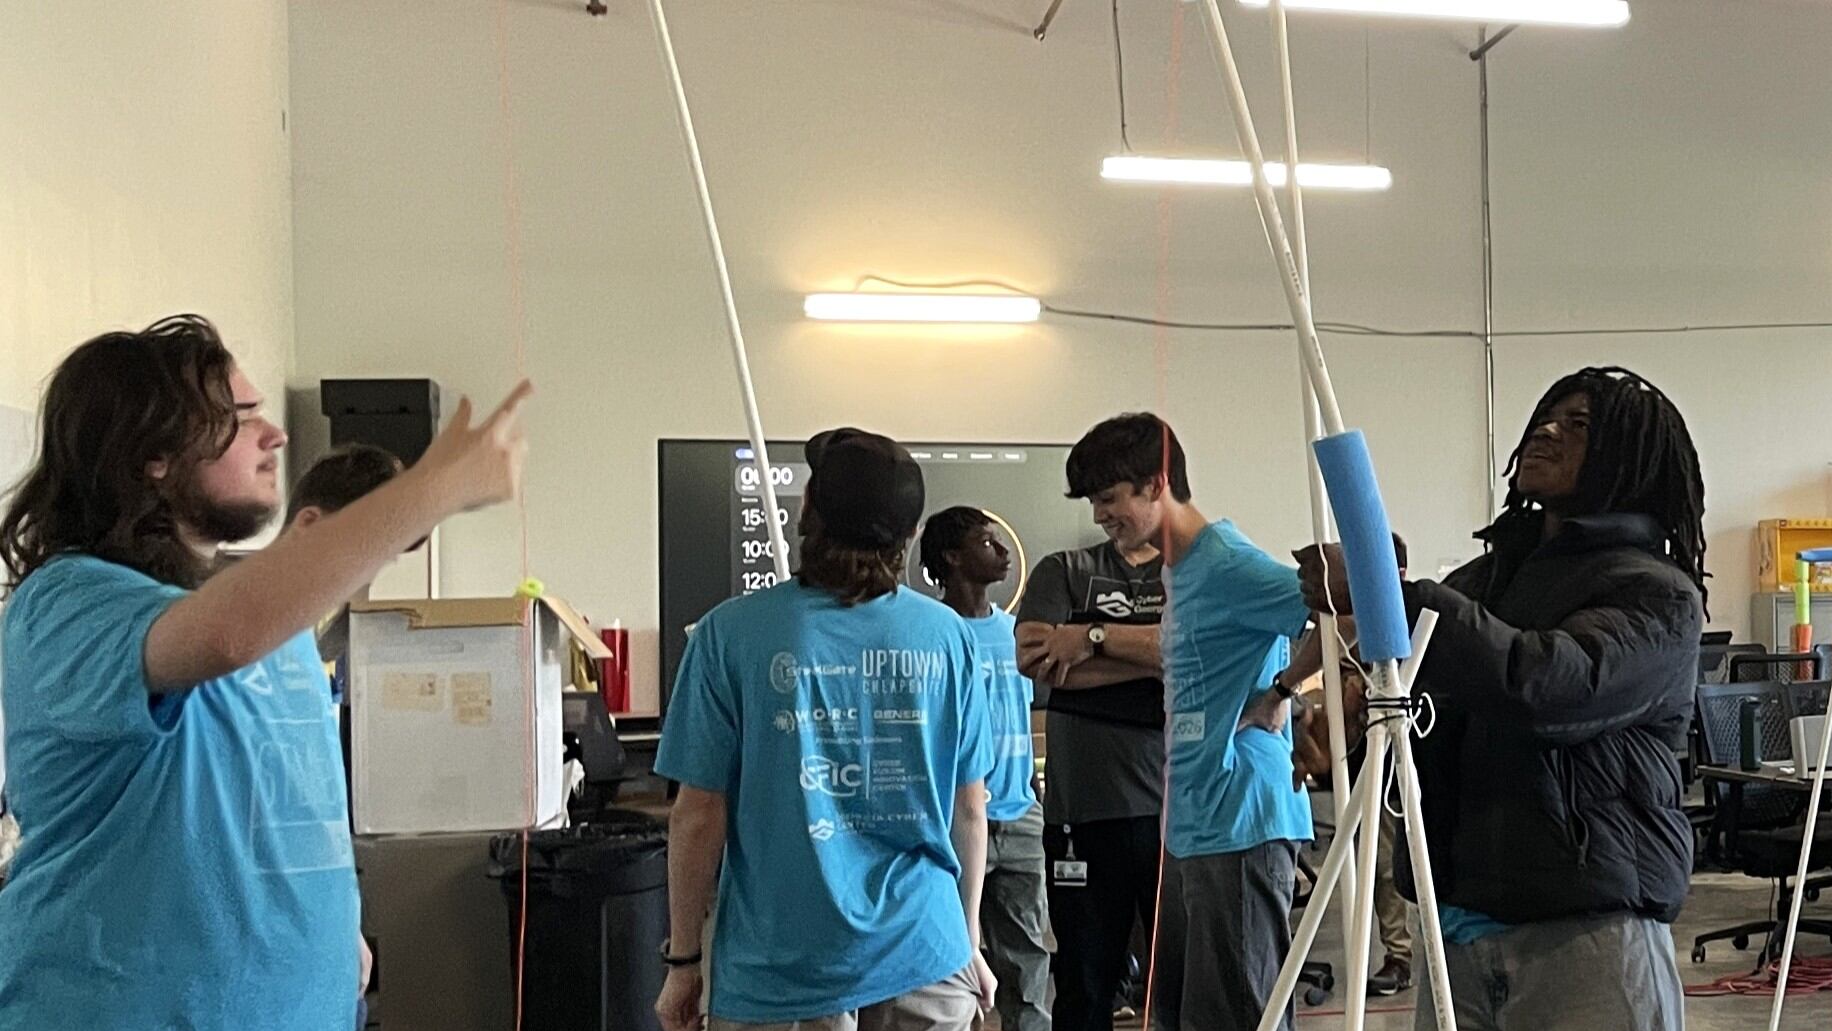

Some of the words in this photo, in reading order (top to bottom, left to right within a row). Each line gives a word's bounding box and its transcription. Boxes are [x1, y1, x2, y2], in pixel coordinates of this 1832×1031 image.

[741, 467, 793, 485] 000
[742, 508, 789, 526] 15:0
[742, 572, 777, 590] 12:0
[862, 649, 944, 678] UPTOWN
